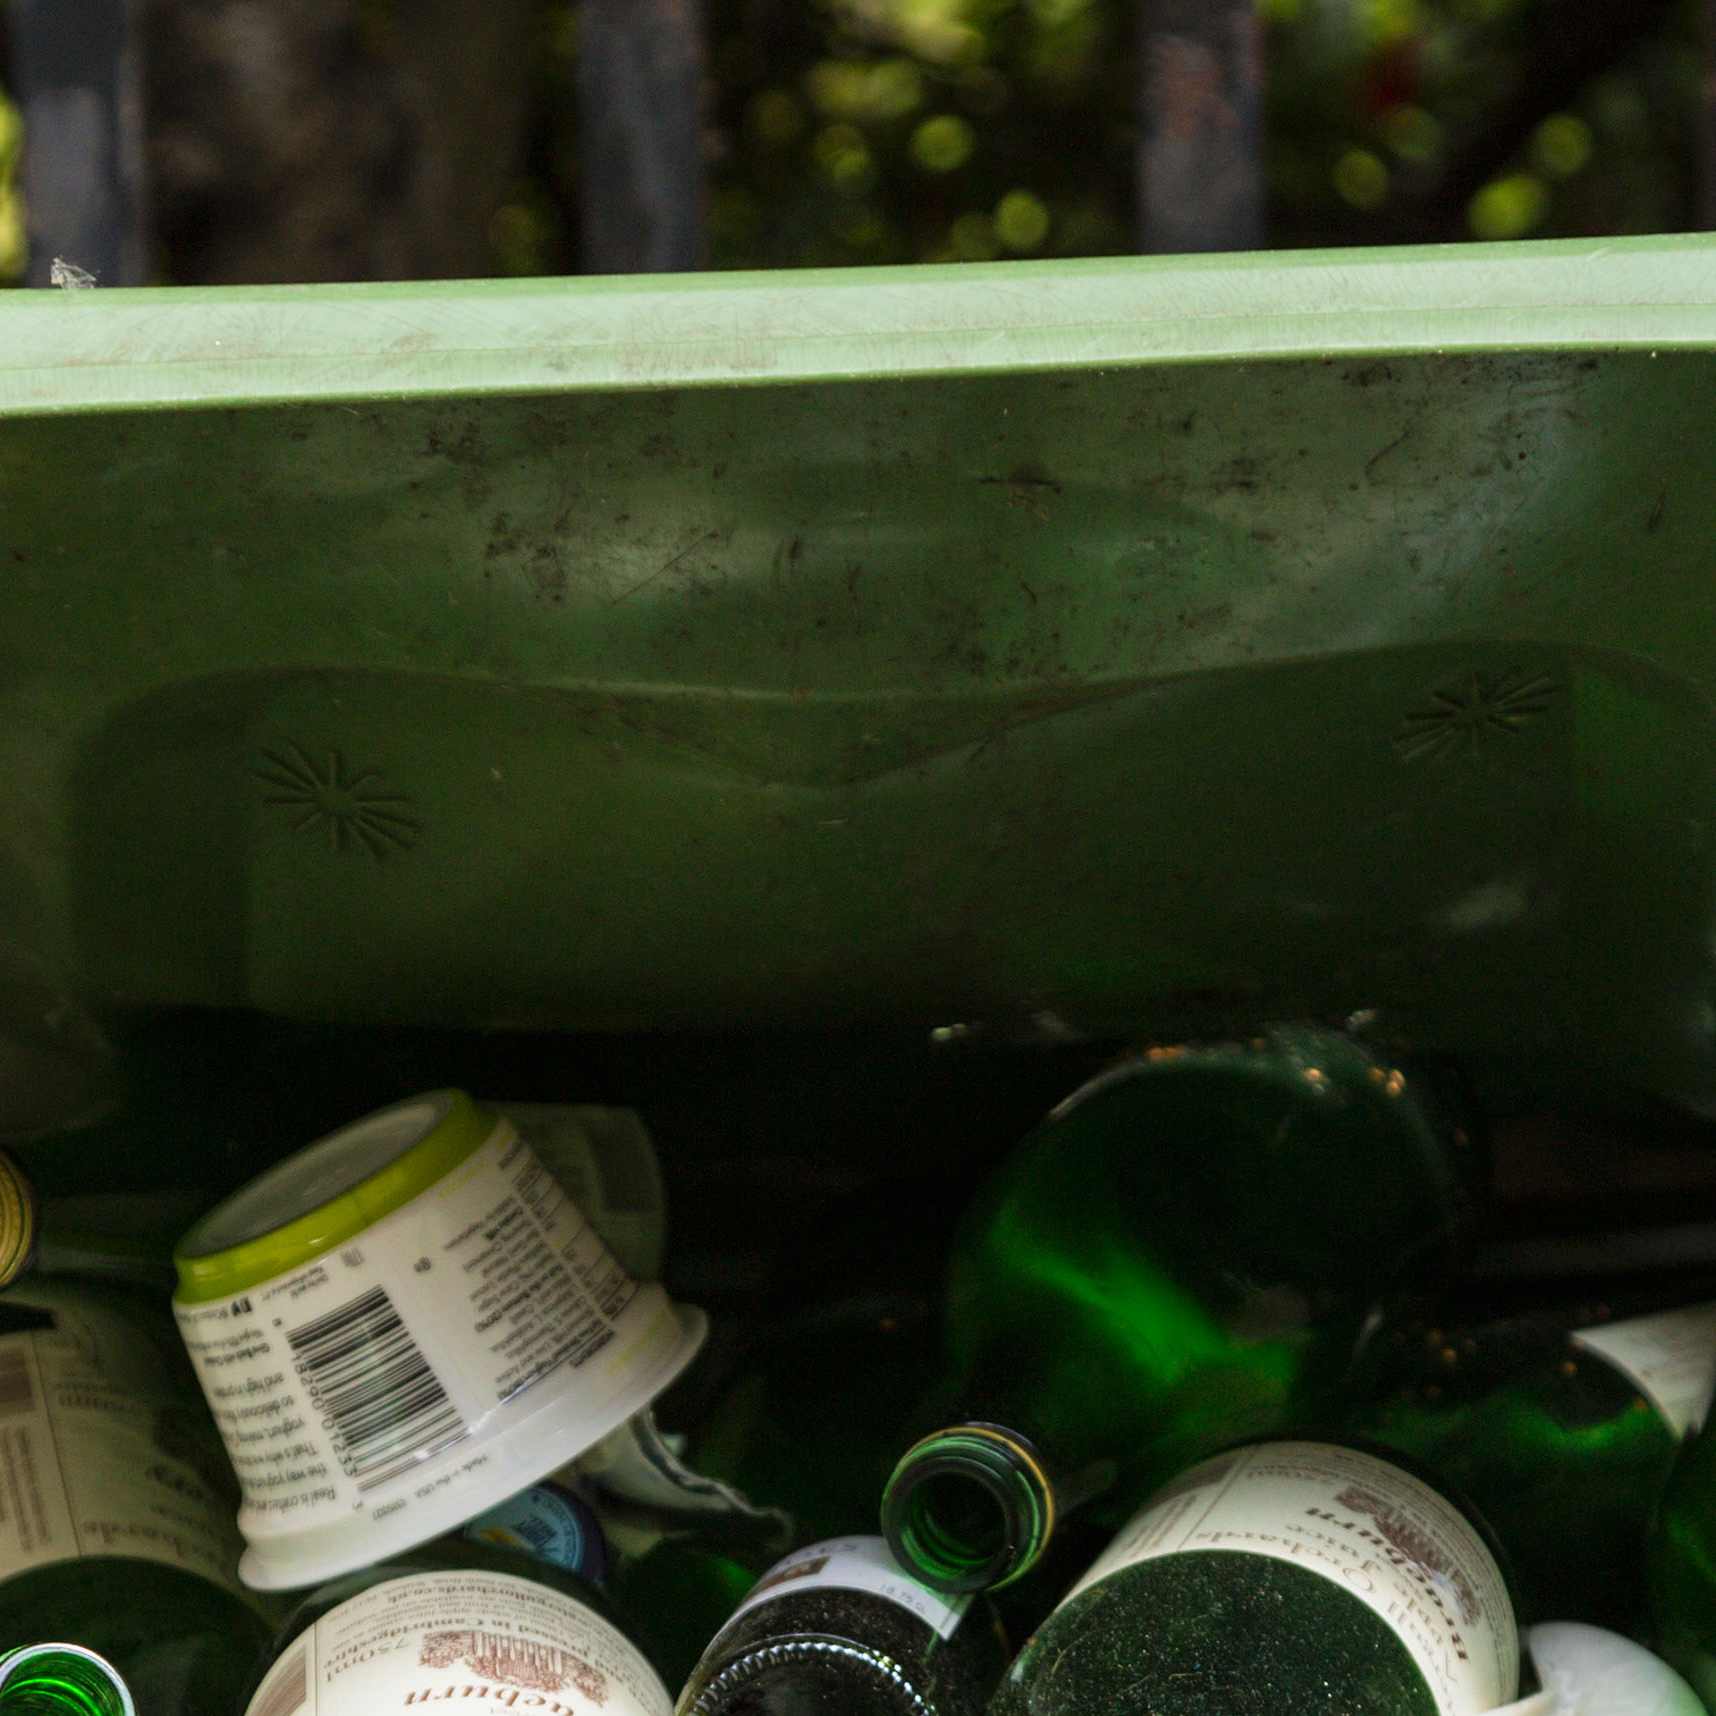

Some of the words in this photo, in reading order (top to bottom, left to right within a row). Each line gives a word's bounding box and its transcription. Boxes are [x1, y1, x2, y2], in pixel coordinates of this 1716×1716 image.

[306, 1460, 328, 1481] the
[308, 1483, 337, 1508] Real
[1305, 1507, 1470, 1661] Braeburn
[323, 1616, 485, 1670] Cambridgeshire
[326, 1636, 410, 1684] 750ml
